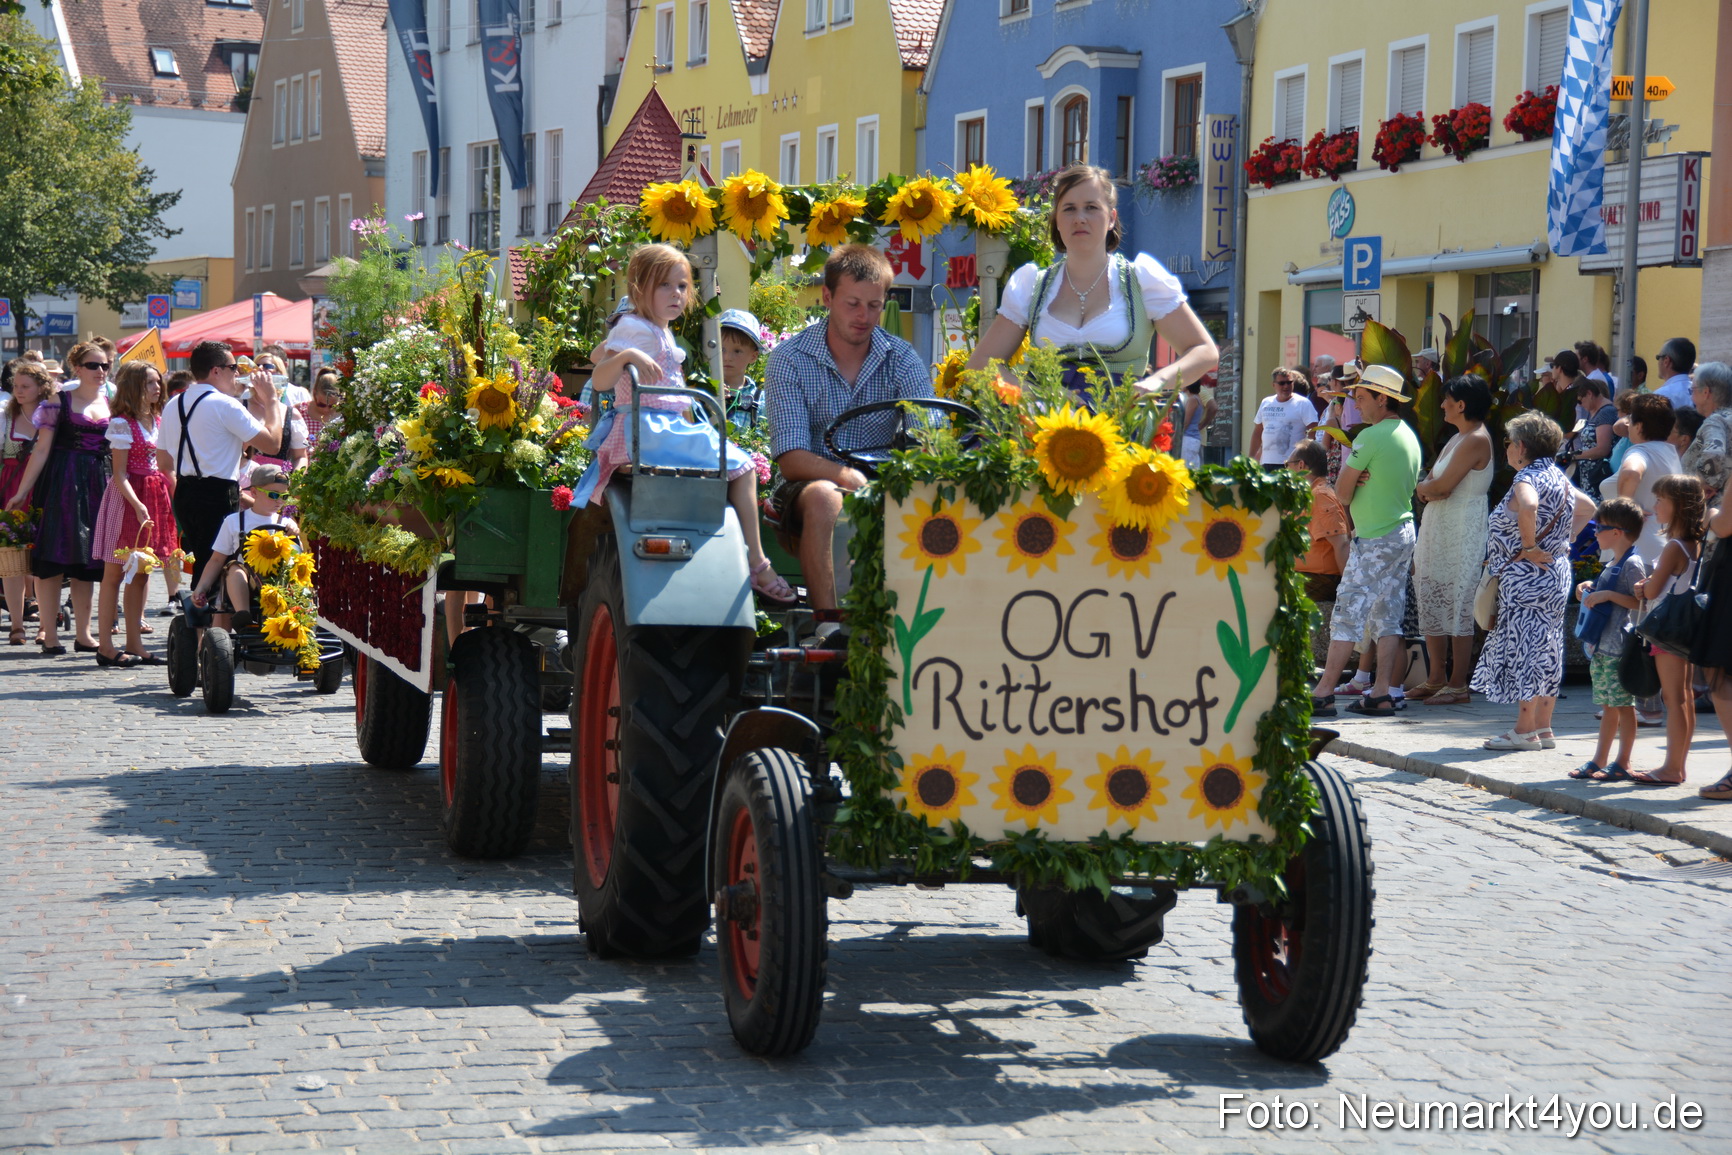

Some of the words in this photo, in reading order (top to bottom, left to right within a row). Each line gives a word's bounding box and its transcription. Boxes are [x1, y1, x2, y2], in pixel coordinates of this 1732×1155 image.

[1612, 80, 1635, 96] KIN
[716, 100, 758, 130] Lehmeier
[1211, 116, 1235, 138] CAFÉ
[1212, 143, 1232, 248] WITTL
[1681, 157, 1698, 258] KINO
[1329, 194, 1351, 241] FASS
[1600, 204, 1628, 226] IALT
[1352, 243, 1374, 285] P
[49, 318, 72, 327] APOLLO
[150, 318, 168, 326] TAXI
[1001, 588, 1177, 662] OGV
[911, 656, 1220, 747] Rittershof
